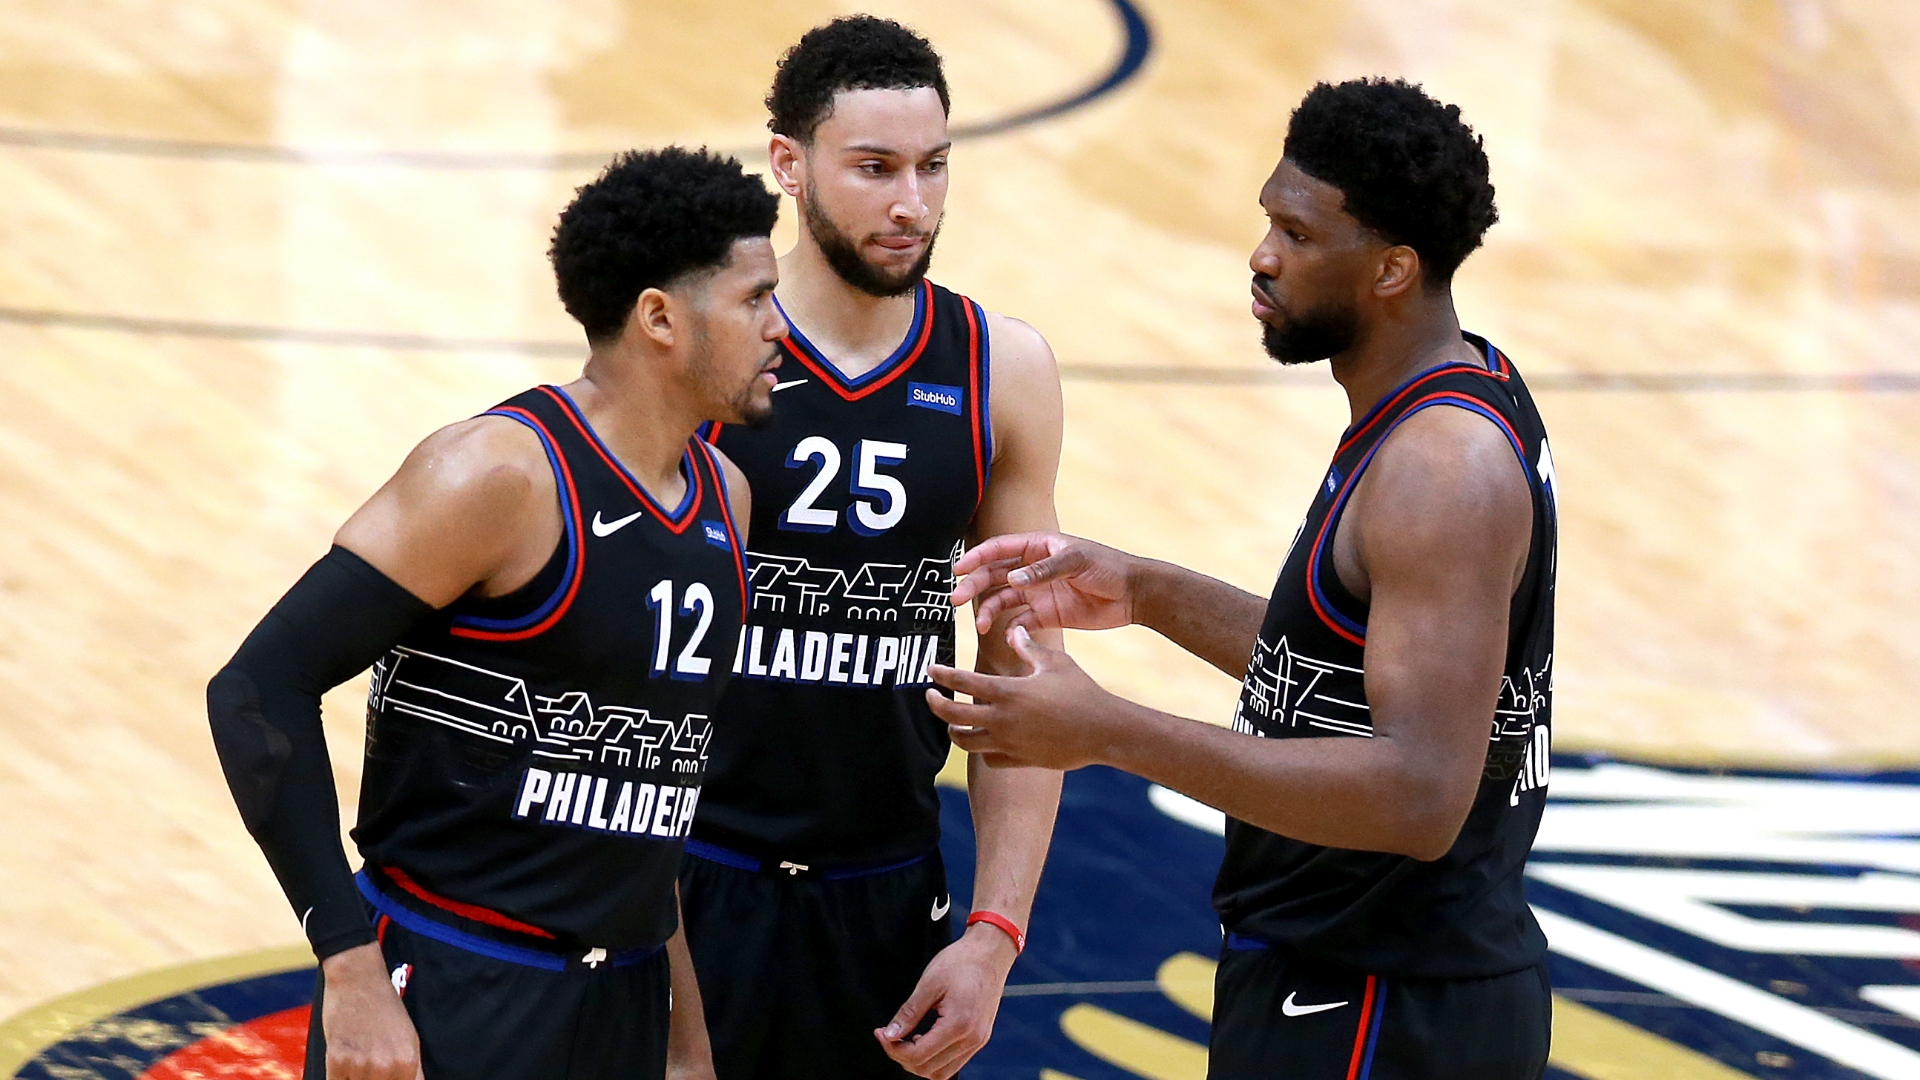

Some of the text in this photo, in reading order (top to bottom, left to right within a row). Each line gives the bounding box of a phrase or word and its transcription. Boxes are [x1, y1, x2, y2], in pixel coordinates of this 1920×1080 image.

[912, 388, 956, 407] StubHub
[782, 435, 908, 534] 25
[647, 579, 714, 678] 12
